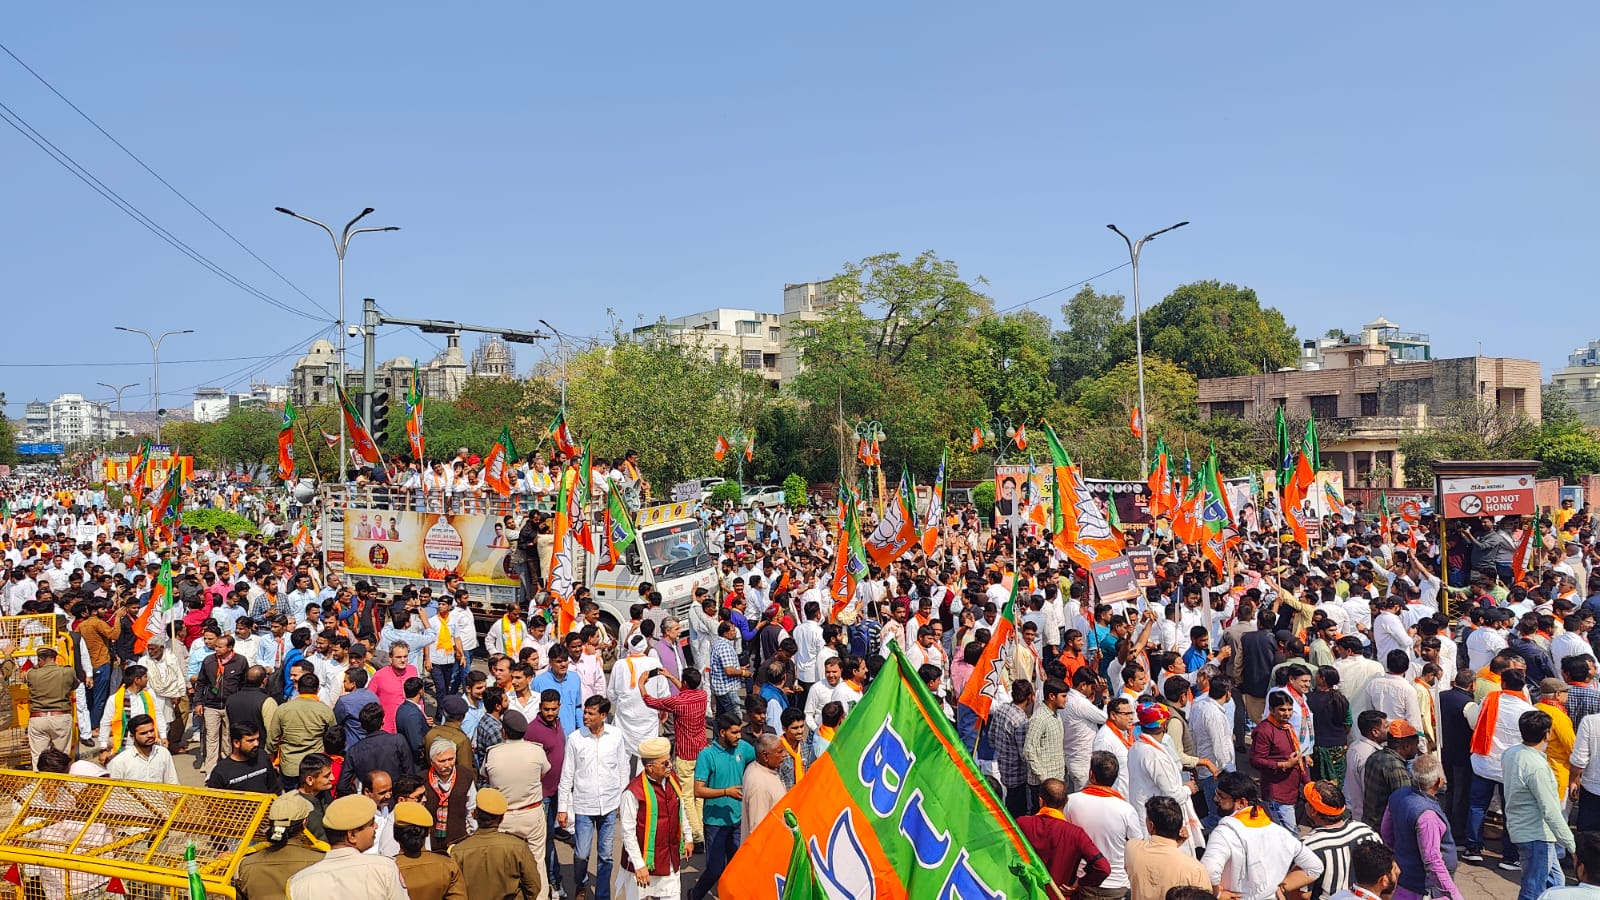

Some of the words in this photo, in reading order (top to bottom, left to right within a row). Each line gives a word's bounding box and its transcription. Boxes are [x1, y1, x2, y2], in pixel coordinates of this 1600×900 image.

[1485, 495, 1499, 504] DO
[1501, 494, 1520, 502] NOT
[1486, 503, 1513, 512] HONK
